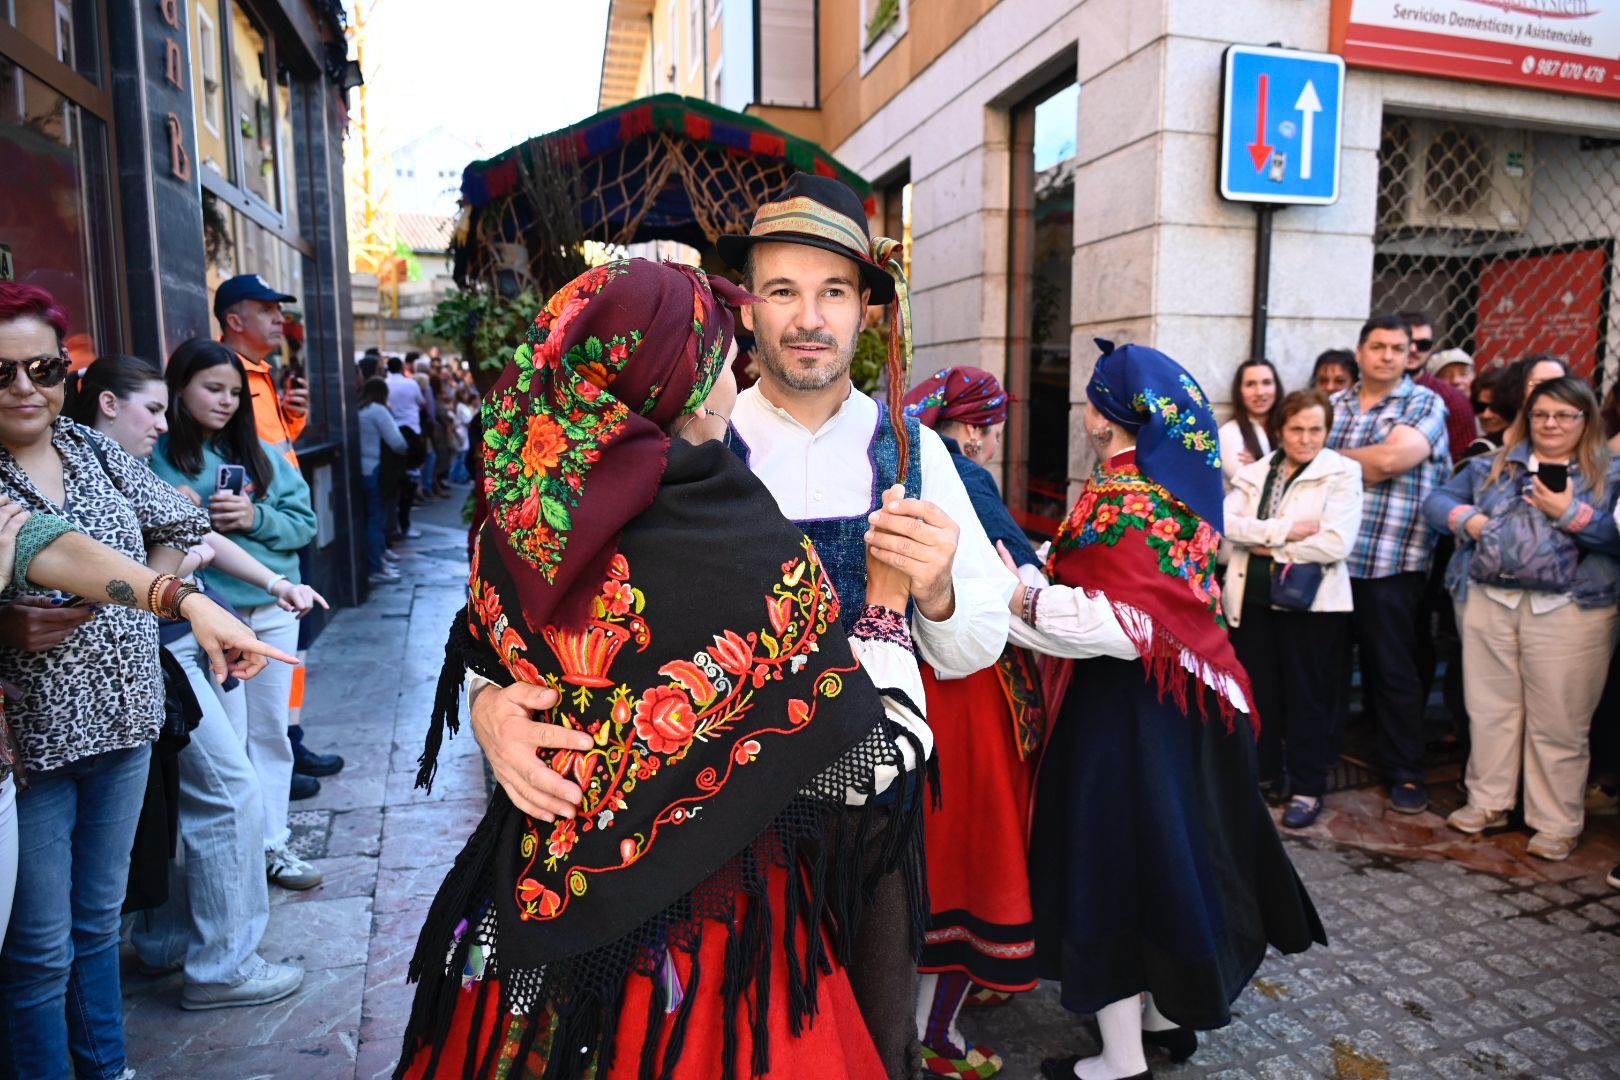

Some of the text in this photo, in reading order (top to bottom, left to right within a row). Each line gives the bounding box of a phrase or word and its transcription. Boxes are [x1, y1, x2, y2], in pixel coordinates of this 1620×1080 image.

[1393, 4, 1447, 25] Servicios
[1448, 11, 1513, 36] Domésticos
[1514, 24, 1523, 40] y
[1524, 23, 1593, 47] Asistenciales
[1536, 58, 1607, 83] 987 070 478
